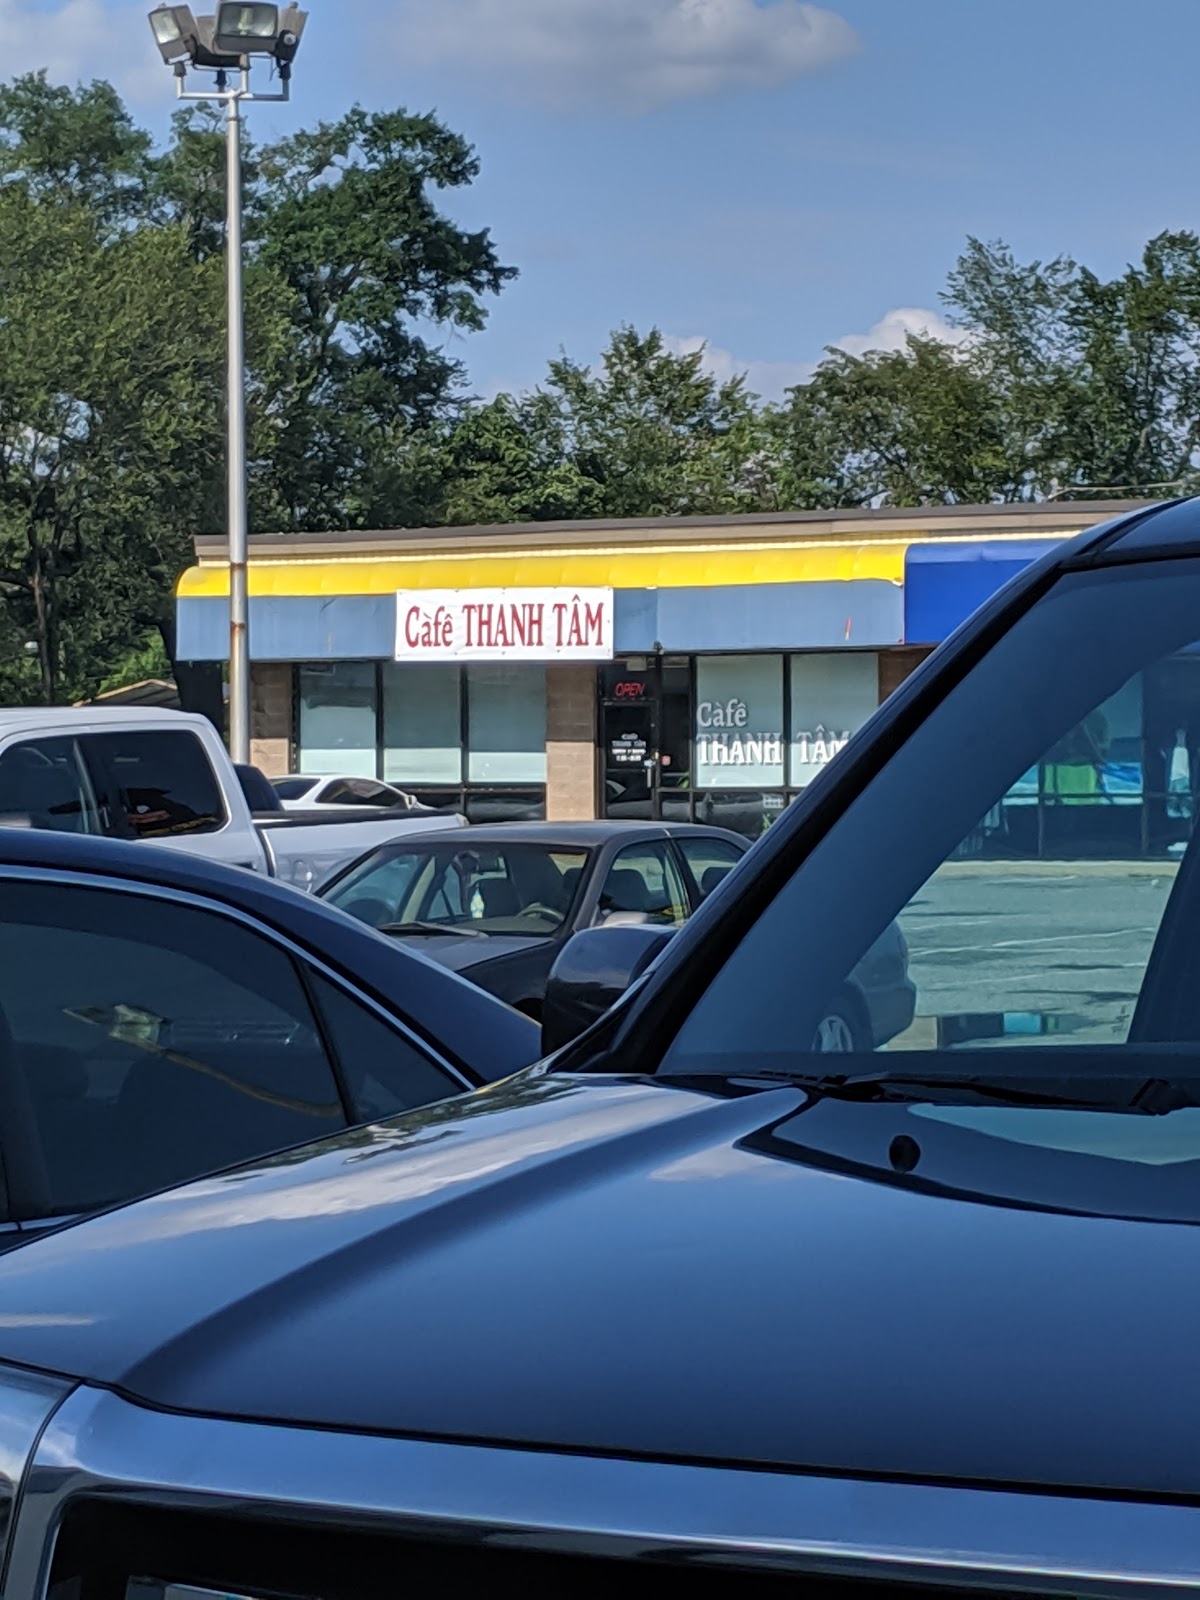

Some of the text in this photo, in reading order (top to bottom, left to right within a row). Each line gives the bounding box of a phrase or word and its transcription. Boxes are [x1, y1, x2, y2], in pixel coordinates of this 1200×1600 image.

[461, 603, 544, 647] THANH
[552, 593, 604, 647] TÂM
[614, 682, 645, 697] OPEN
[696, 724, 850, 766] THANH TÂM
